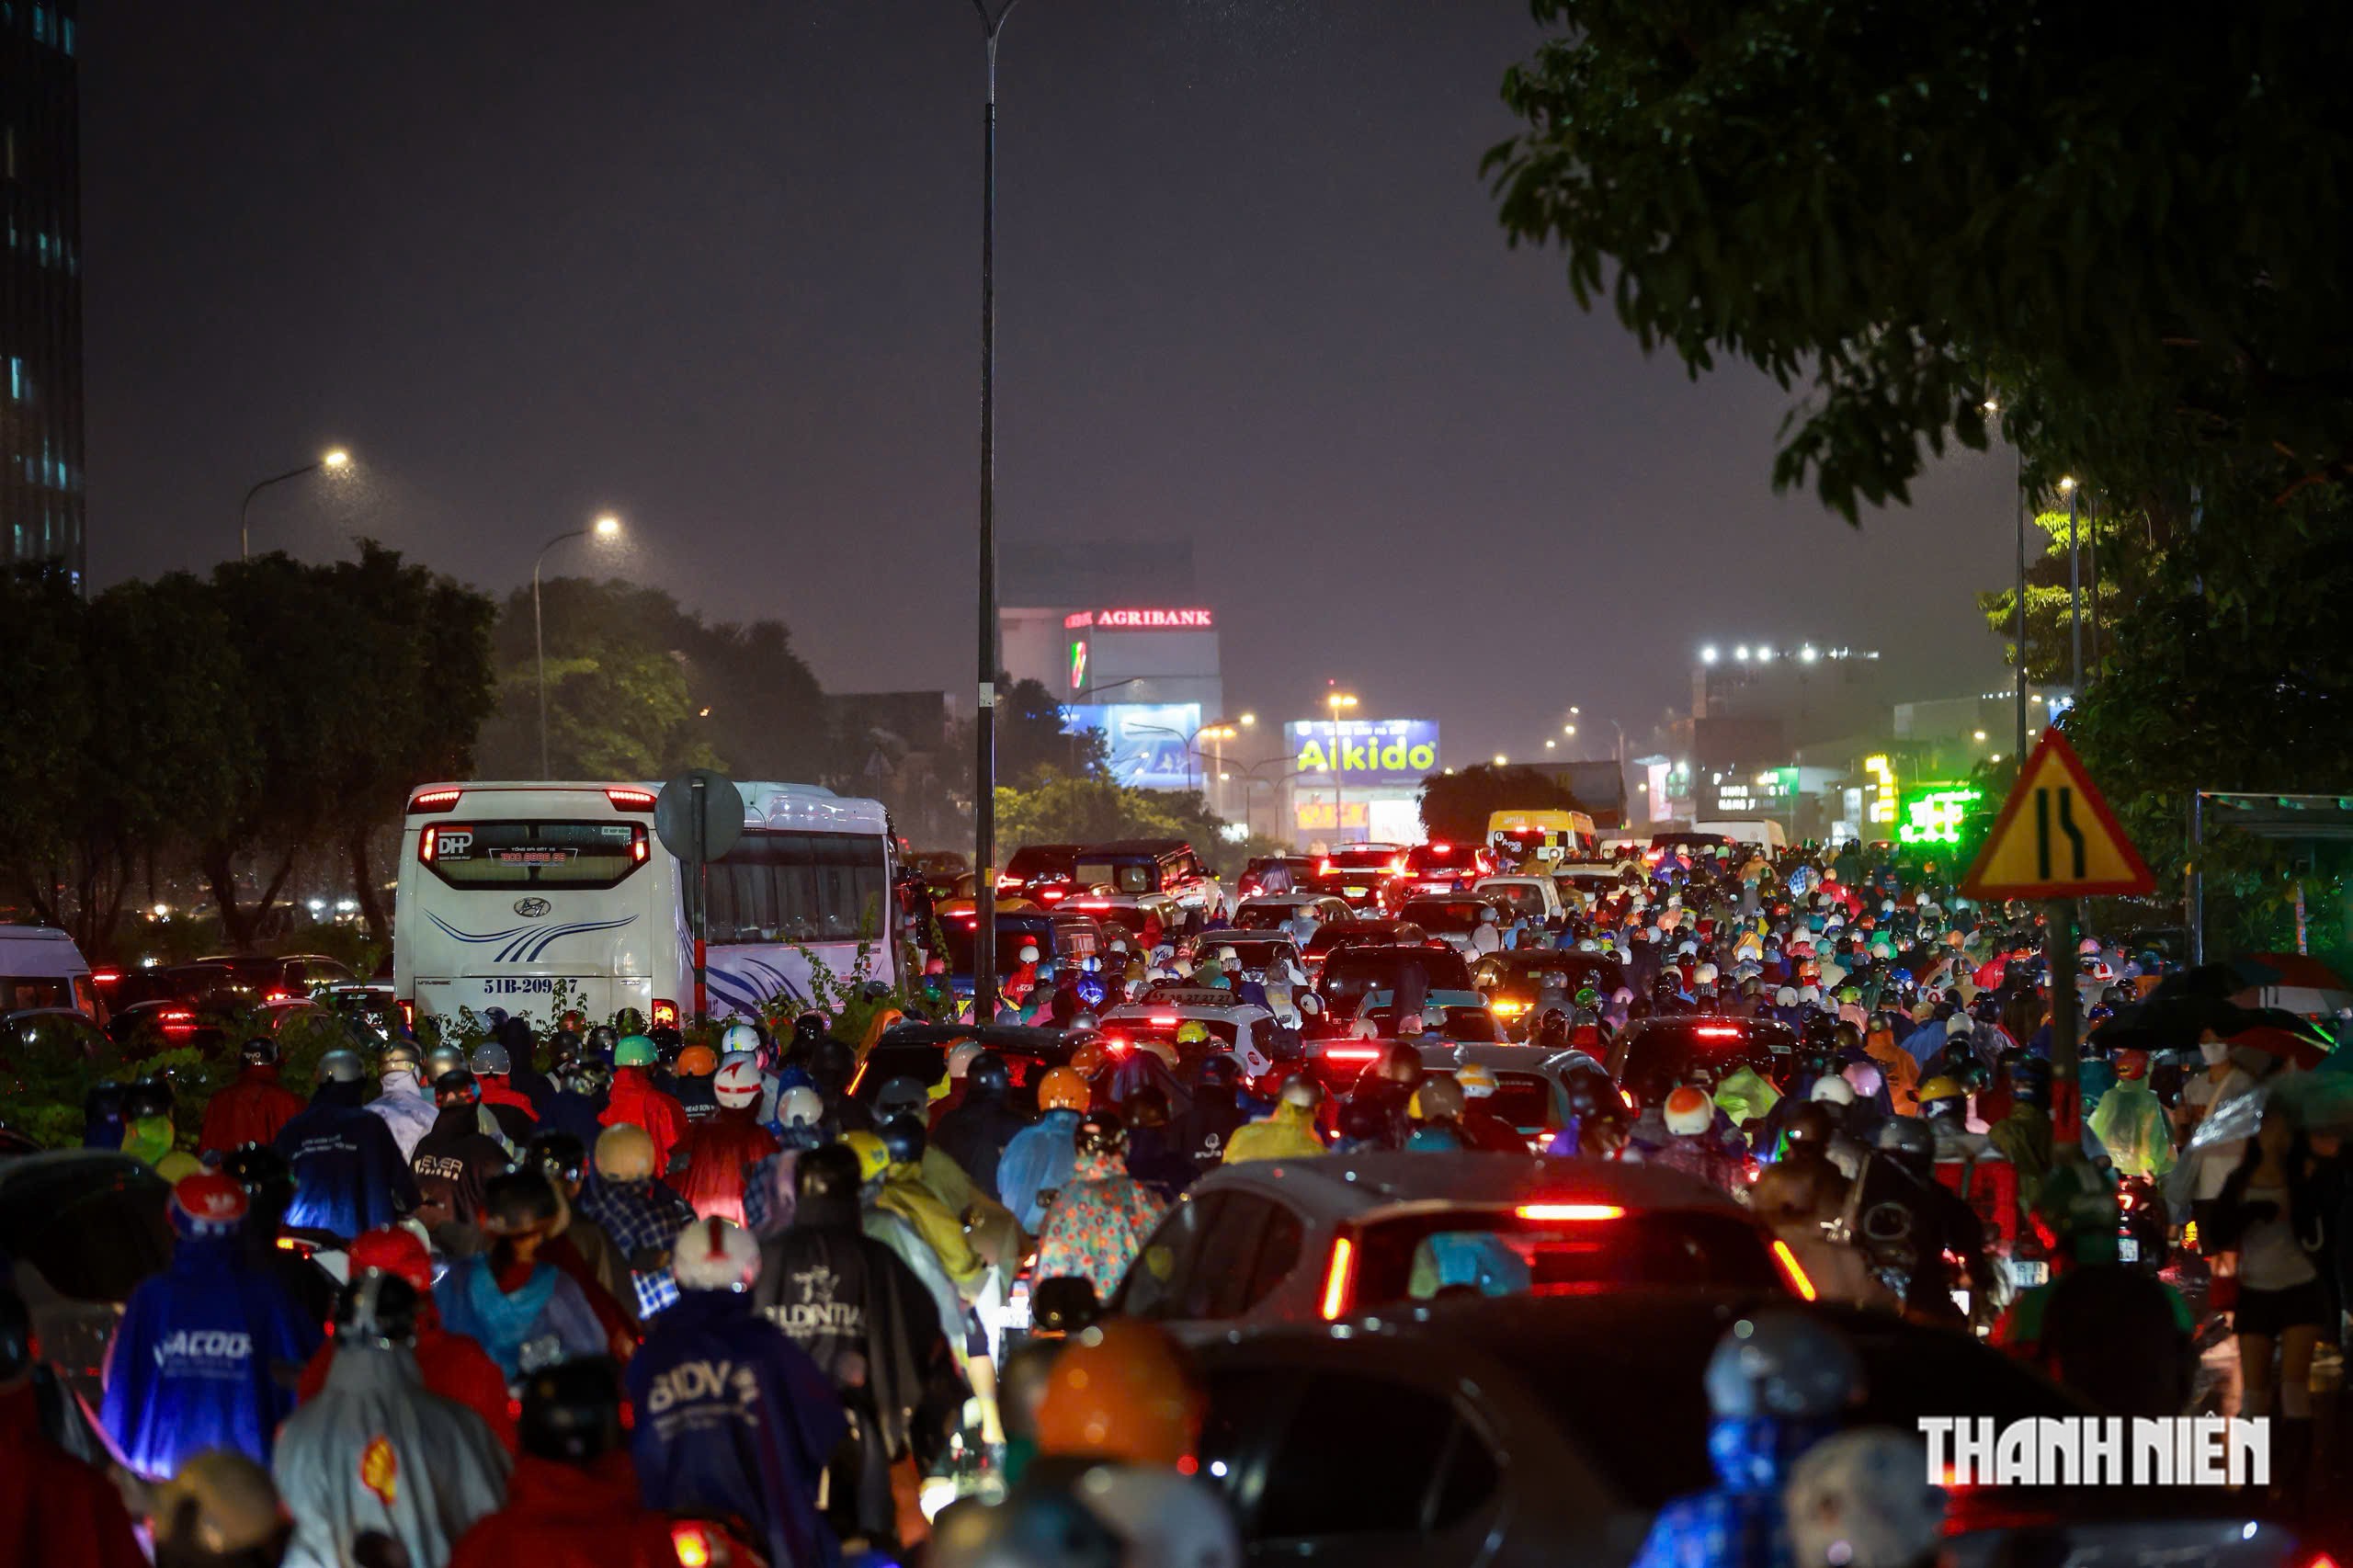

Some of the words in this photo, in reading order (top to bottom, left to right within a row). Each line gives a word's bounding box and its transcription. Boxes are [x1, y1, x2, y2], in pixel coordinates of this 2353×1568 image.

[1098, 610, 1211, 626] AGRIBANK
[1297, 736, 1435, 771] Aikido
[438, 832, 473, 854] DHP
[648, 1359, 732, 1414] BIDV
